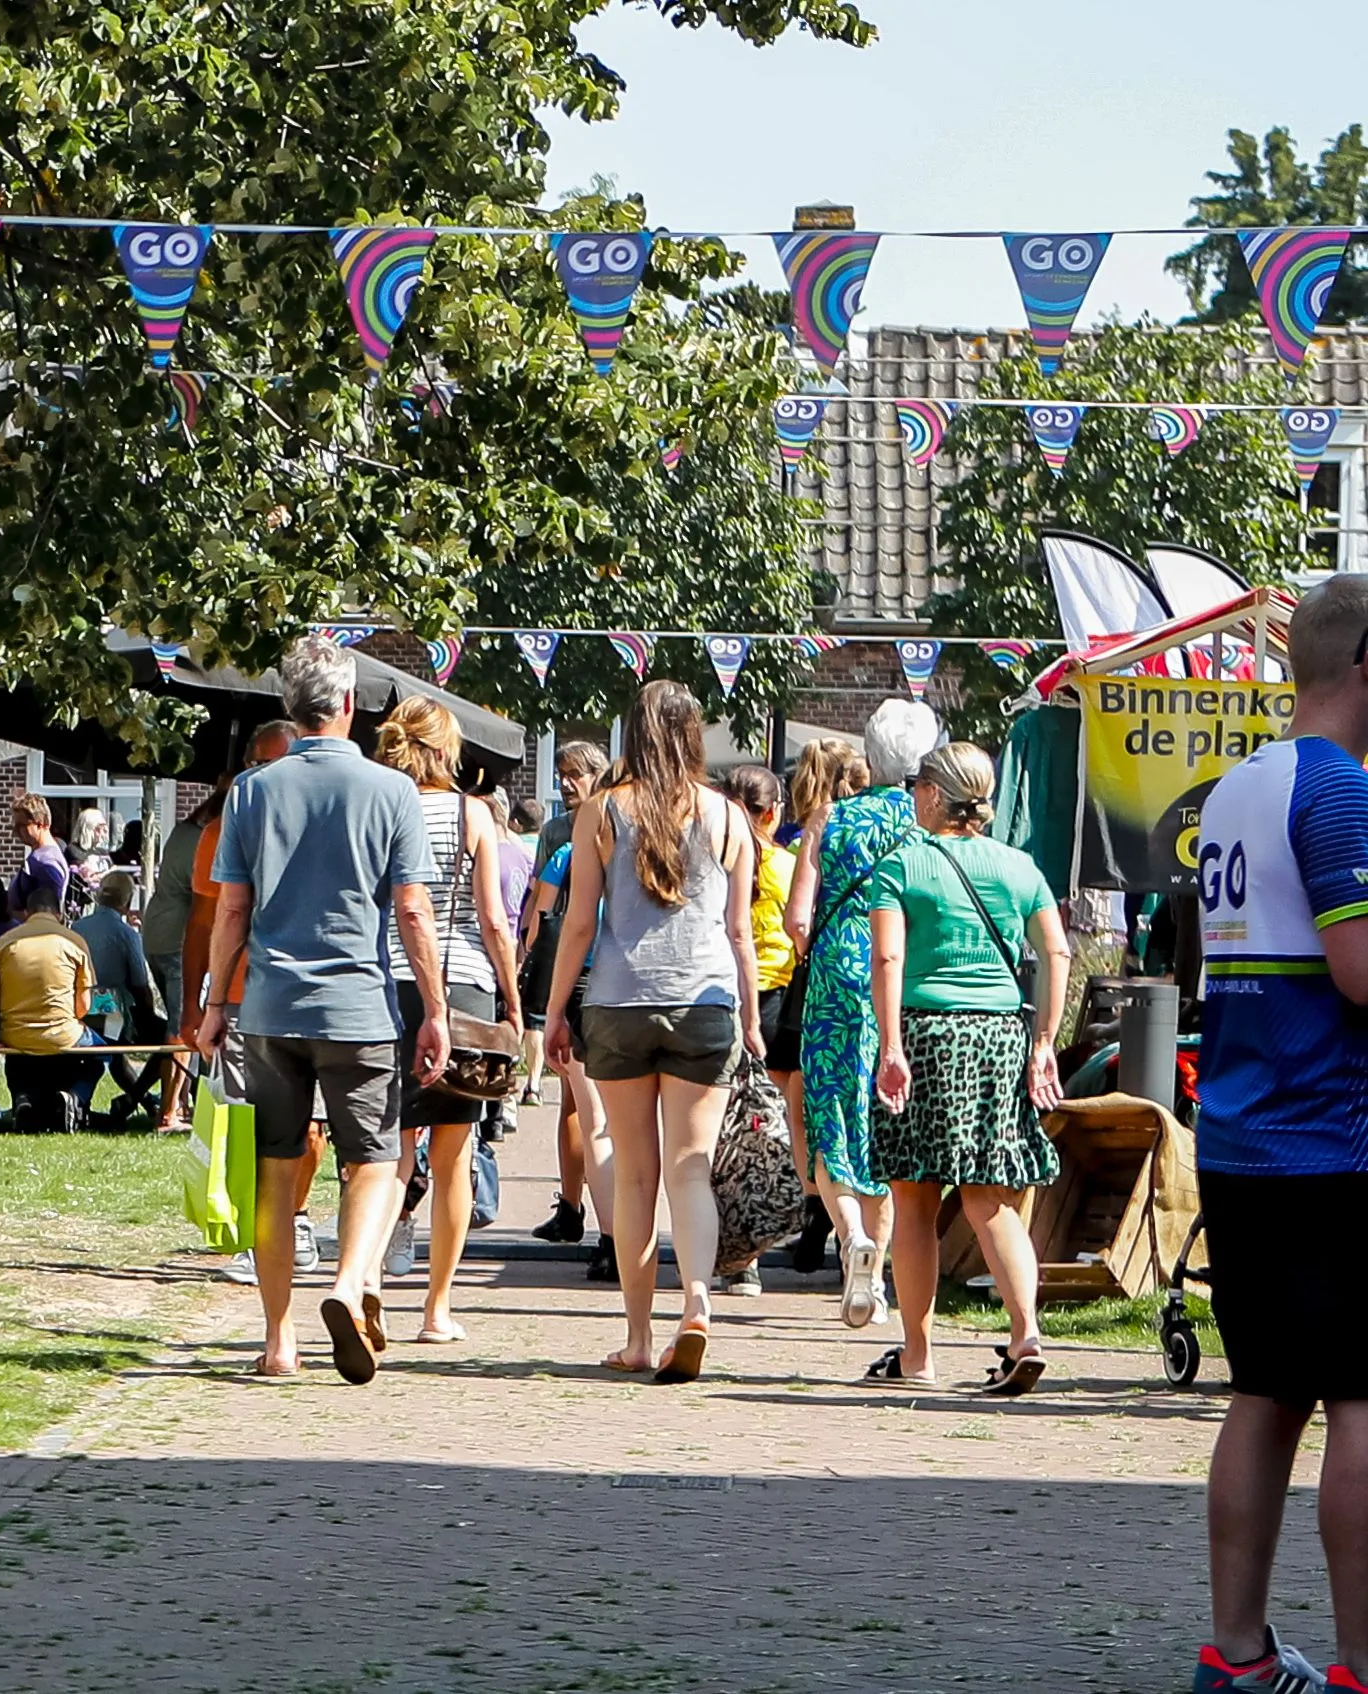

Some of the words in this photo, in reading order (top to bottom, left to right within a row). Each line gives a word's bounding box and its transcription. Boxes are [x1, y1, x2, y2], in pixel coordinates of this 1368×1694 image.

[129, 232, 198, 266] GO
[568, 238, 638, 273] GO
[1021, 237, 1093, 271] GO
[1099, 682, 1296, 718] Binnenko
[1125, 719, 1174, 756] de
[1199, 840, 1246, 914] GO
